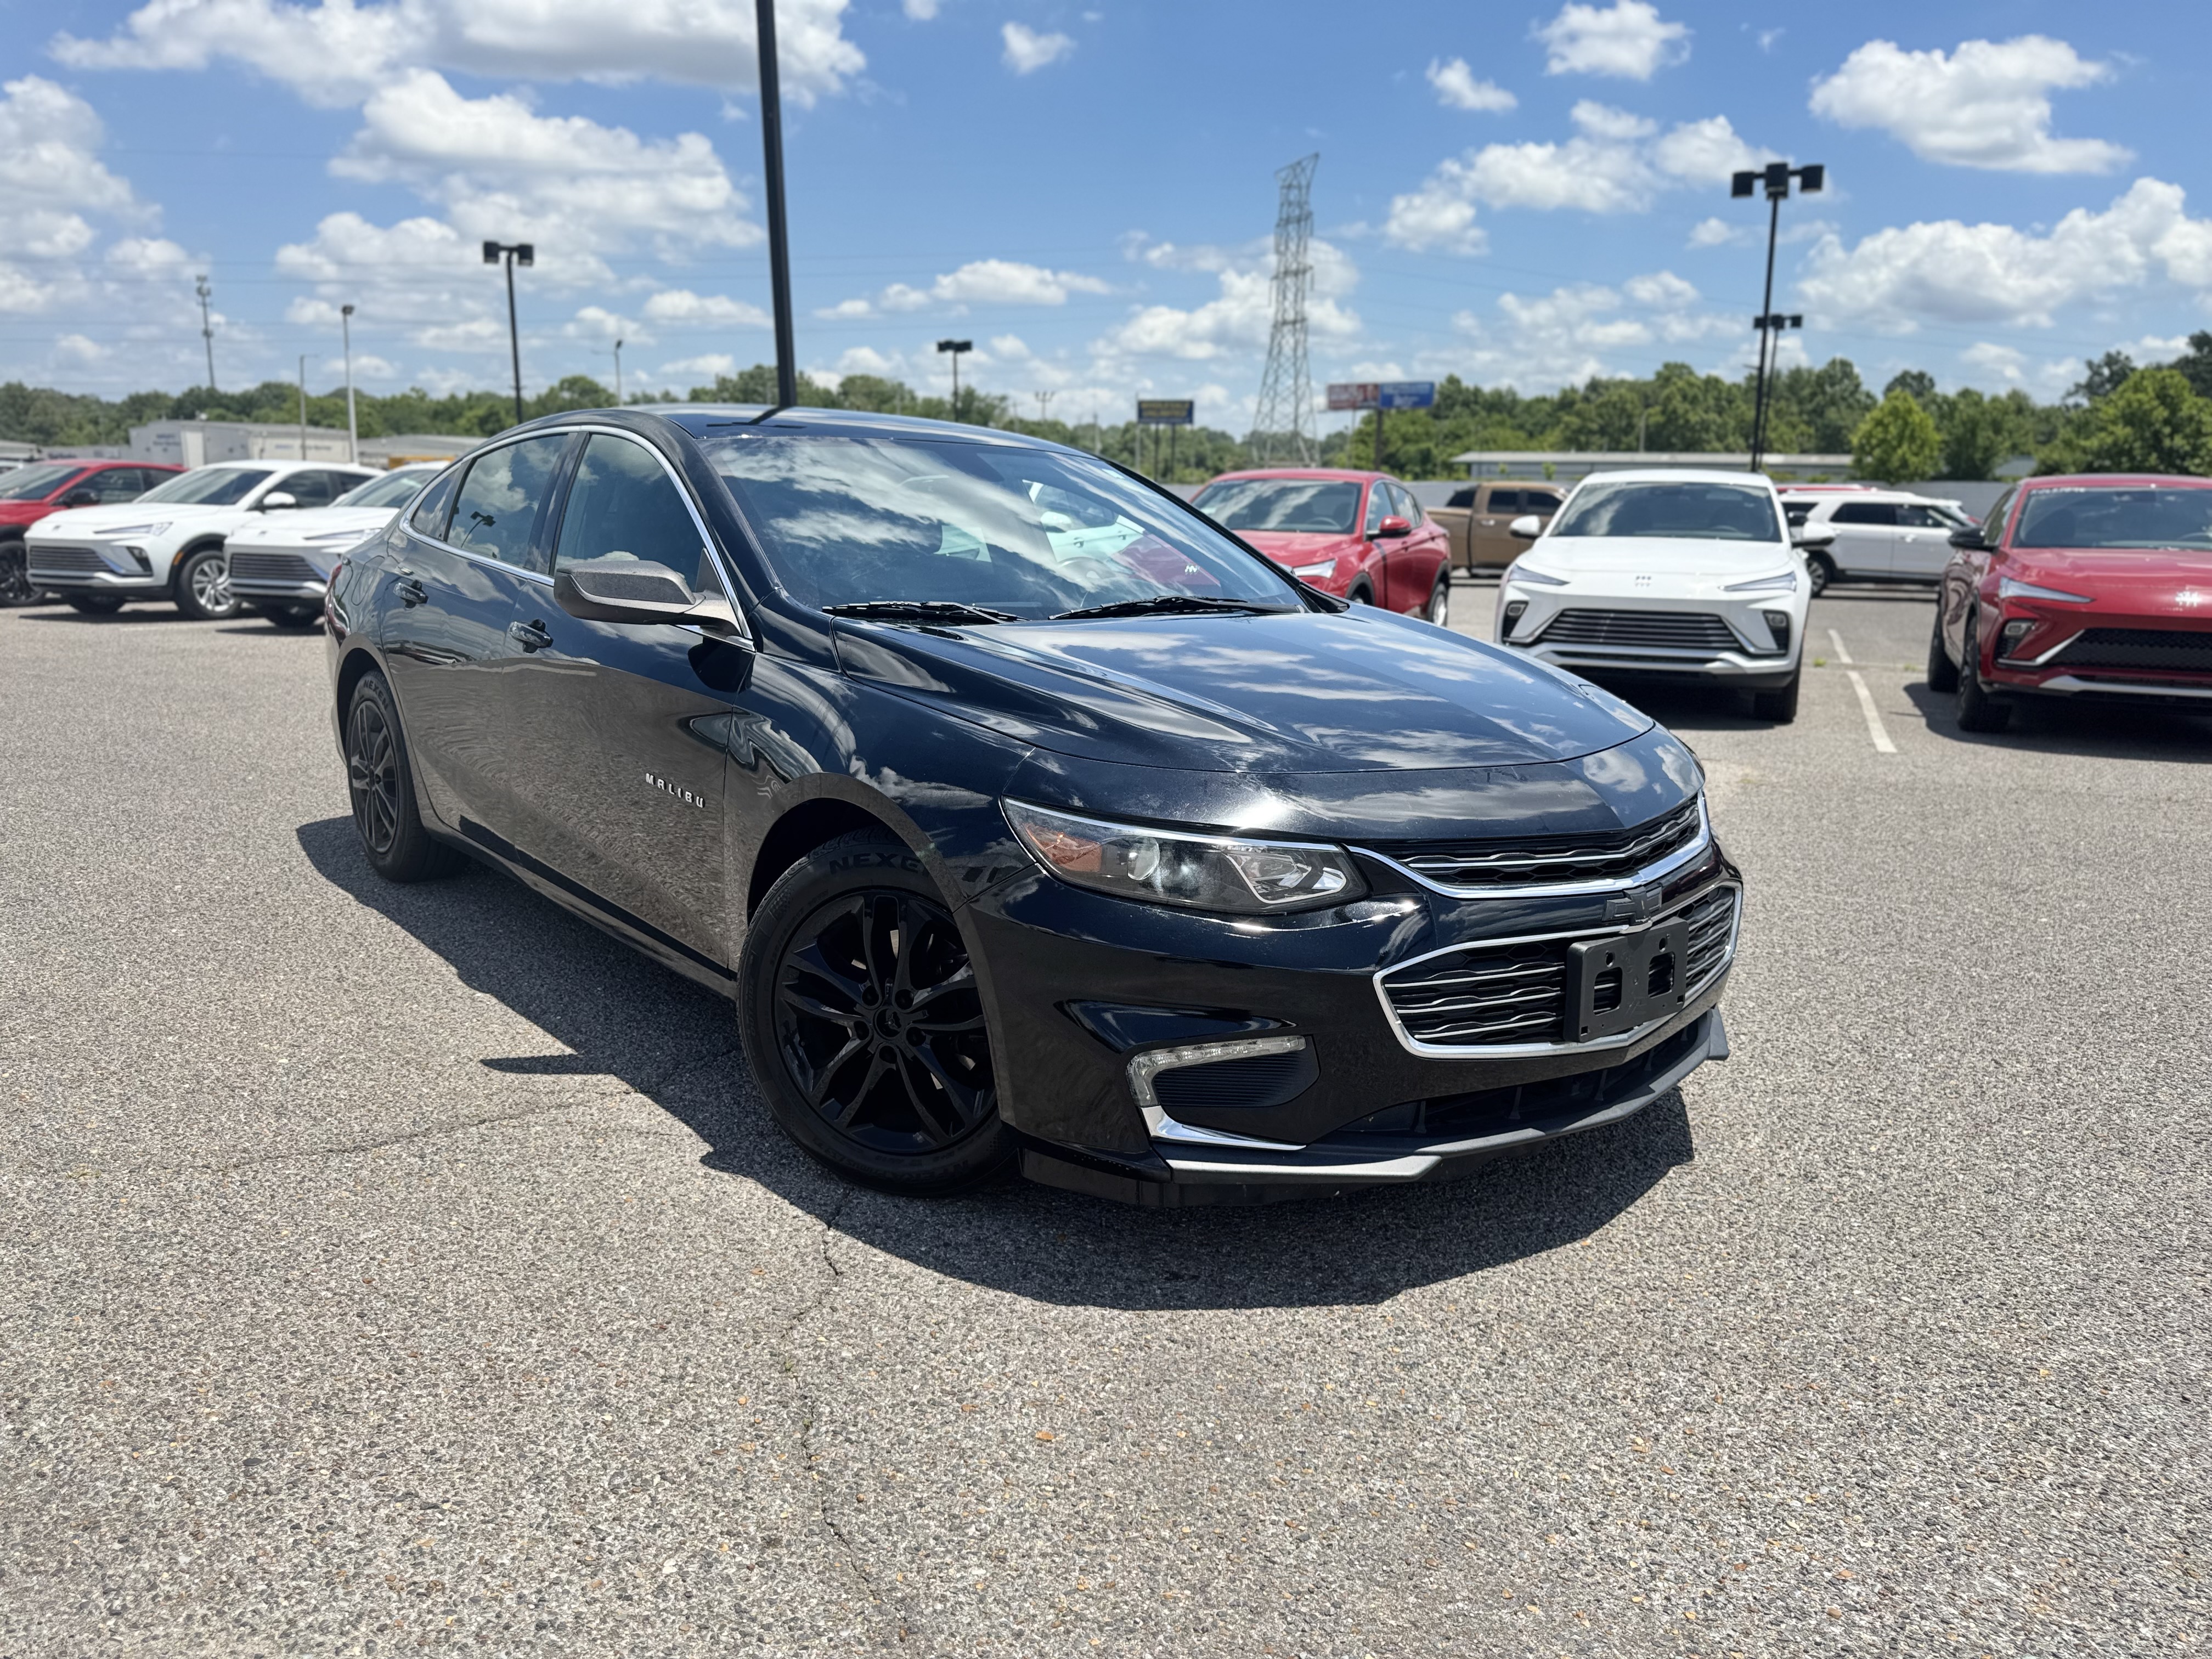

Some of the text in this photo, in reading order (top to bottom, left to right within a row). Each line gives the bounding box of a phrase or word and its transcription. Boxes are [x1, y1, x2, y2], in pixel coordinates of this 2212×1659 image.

[364, 680, 388, 712] NEXEN
[646, 773, 704, 808] MALIBU
[829, 851, 930, 877] NEXE
